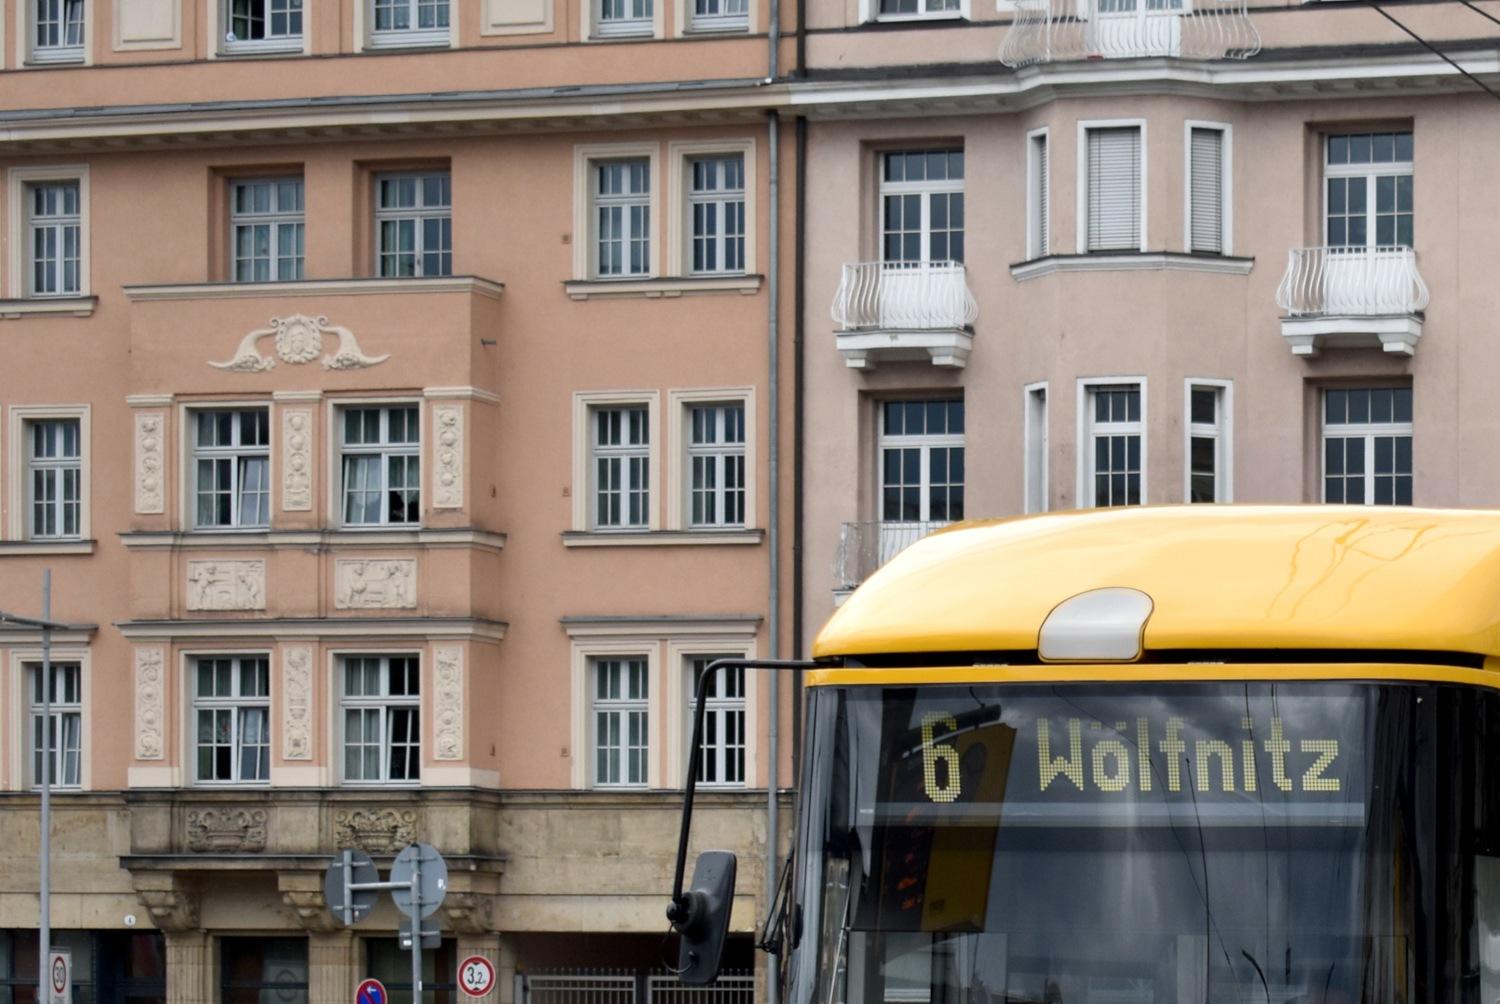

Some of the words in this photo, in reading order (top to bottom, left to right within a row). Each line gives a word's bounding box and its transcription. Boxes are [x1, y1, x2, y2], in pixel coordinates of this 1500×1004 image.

[922, 711, 961, 803] 6
[1037, 716, 1341, 792] Wölfnitz
[55, 966, 65, 983] 30
